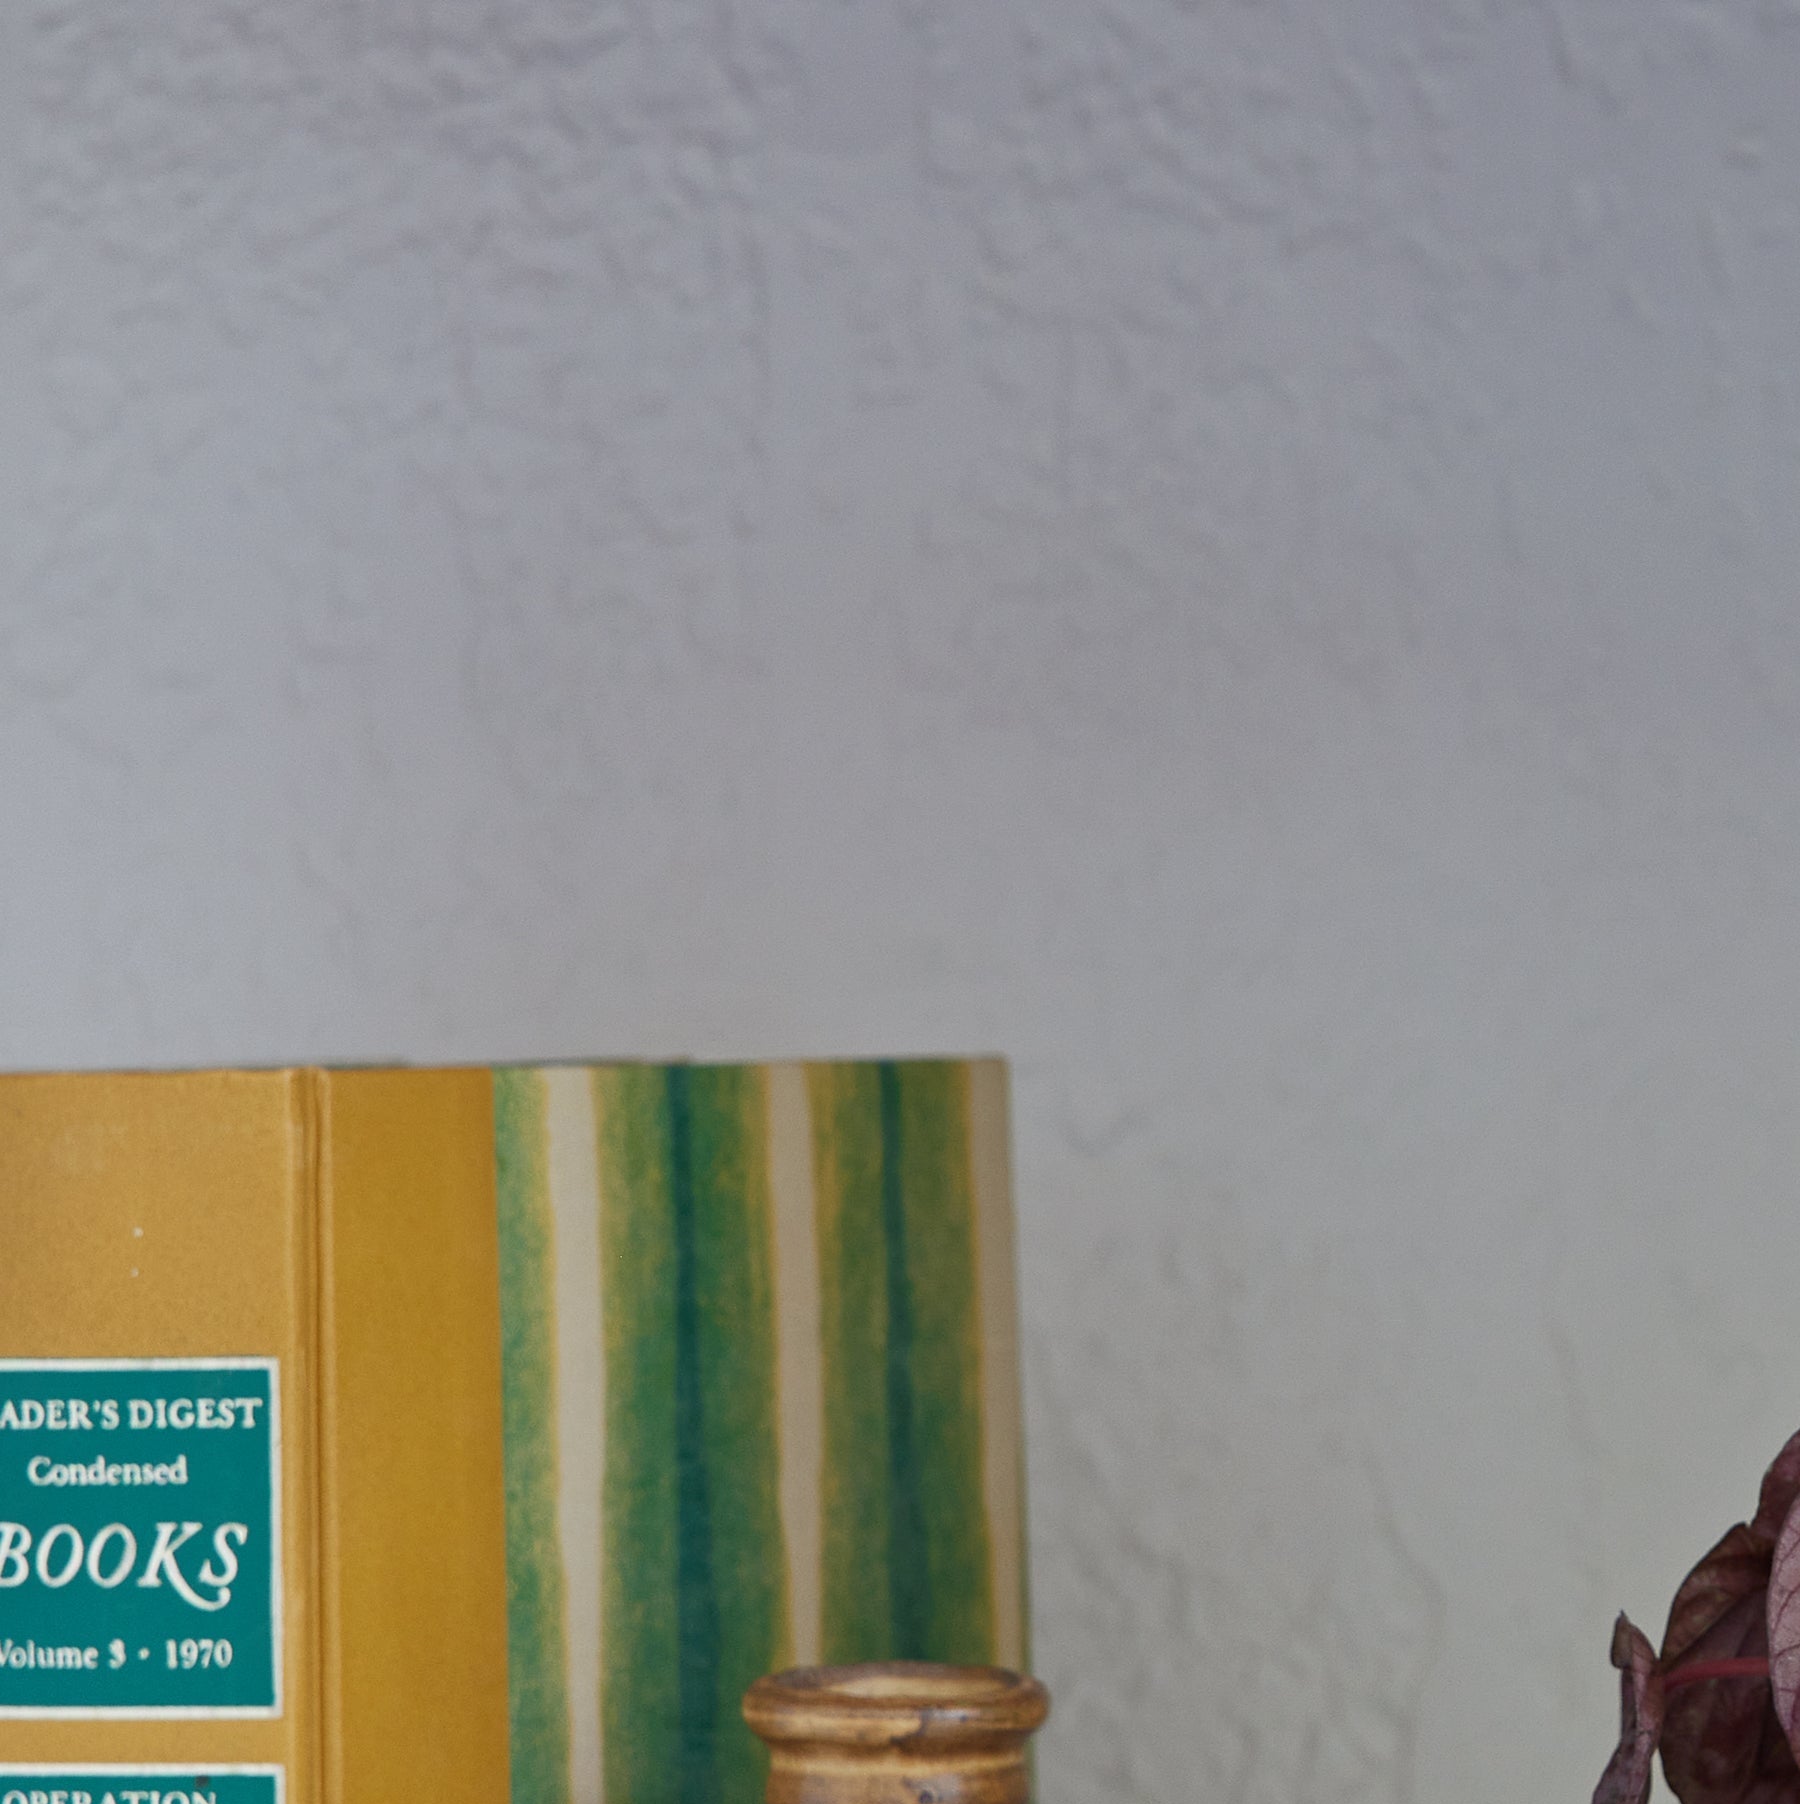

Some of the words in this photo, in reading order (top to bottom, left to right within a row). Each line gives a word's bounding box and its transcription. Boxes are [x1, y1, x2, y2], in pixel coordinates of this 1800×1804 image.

[128, 1397, 263, 1430] DIGEST
[27, 1454, 189, 1487] Condensed
[0, 1521, 249, 1612] BOOKS
[108, 1639, 127, 1669] 3
[165, 1638, 234, 1670] 1970
